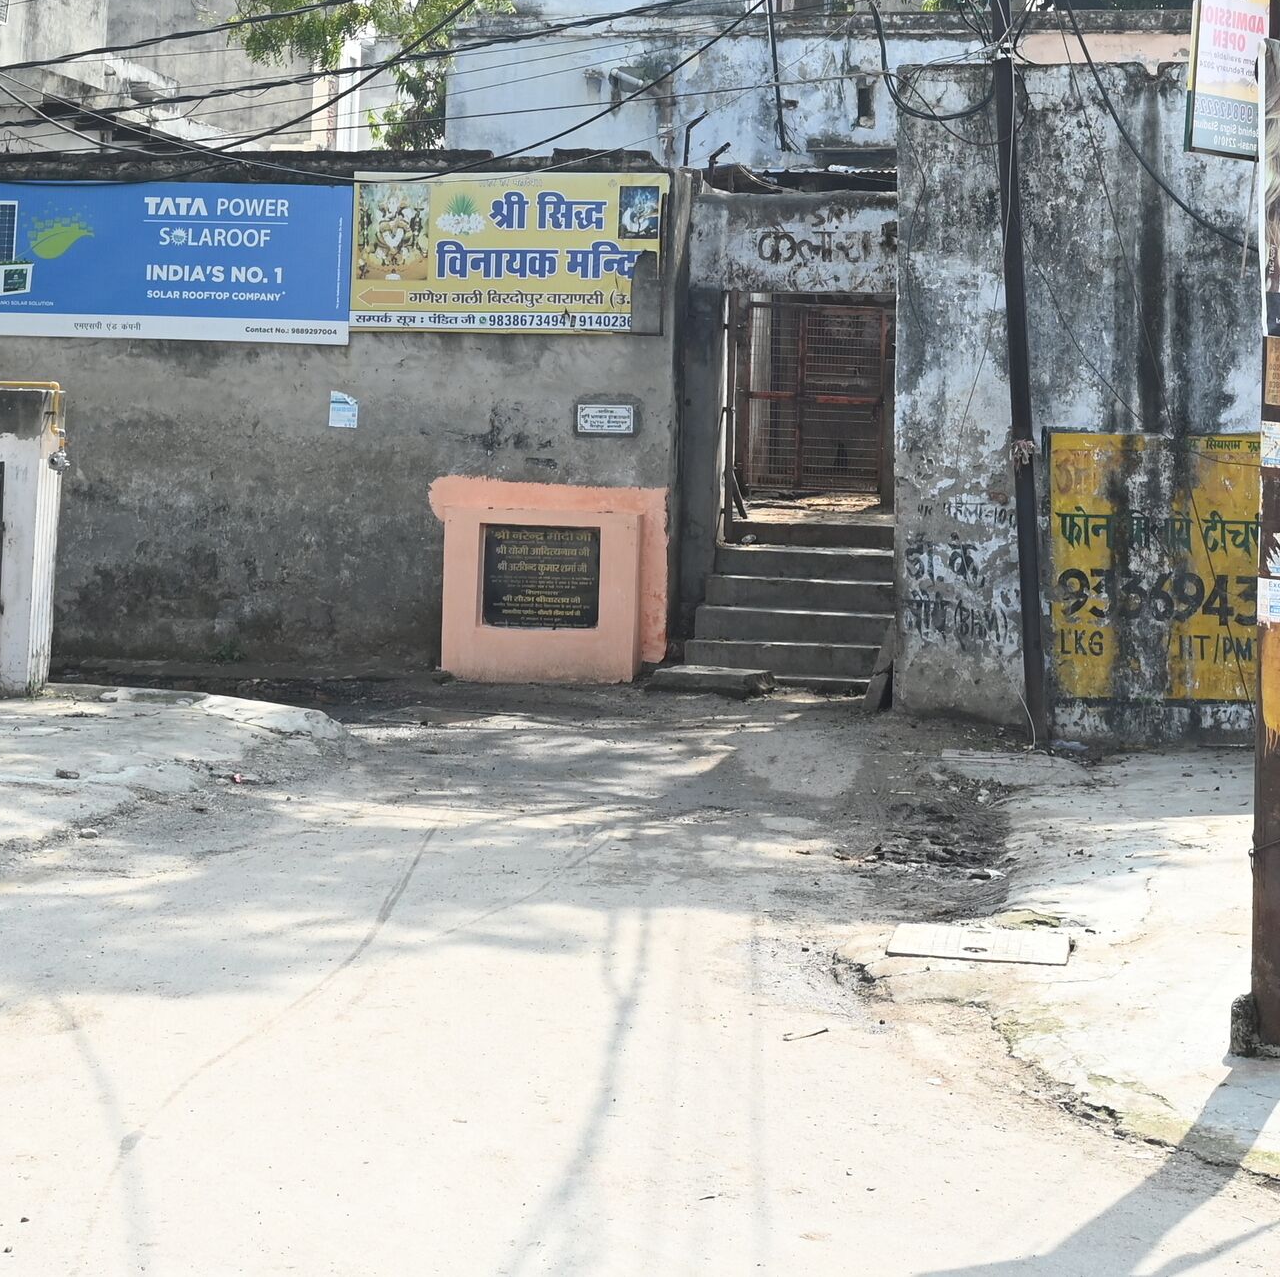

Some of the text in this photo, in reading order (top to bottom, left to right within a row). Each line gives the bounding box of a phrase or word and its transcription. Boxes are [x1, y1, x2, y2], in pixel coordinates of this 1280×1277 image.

[144, 197, 289, 217] TATA POWER
[488, 191, 608, 232] श्री सिद्ध
[436, 240, 642, 280] विनायक मन्दि
[146, 264, 282, 284] INDIA'S NO. 1
[146, 290, 180, 299] SOLAR
[182, 290, 230, 300] ROOFTOP
[409, 289, 447, 304] गणेश
[452, 290, 484, 304] गली
[487, 290, 543, 308] बिरदोपुर
[547, 290, 604, 305] वाराणसी
[74, 321, 102, 331] एमएसपी
[121, 321, 141, 331] कंपनी
[355, 313, 393, 324] सम्पर्क
[396, 314, 416, 327] सूत्र
[428, 313, 458, 325] पंडित
[461, 314, 476, 325] जी
[489, 314, 567, 327] 9838673494
[579, 315, 631, 328] 9140236
[245, 326, 273, 334] Contact
[291, 327, 337, 335] 9889297004
[496, 544, 507, 555] श्री
[497, 560, 507, 571] श्री
[537, 563, 560, 575] कुमार
[1059, 627, 1105, 656] LKG
